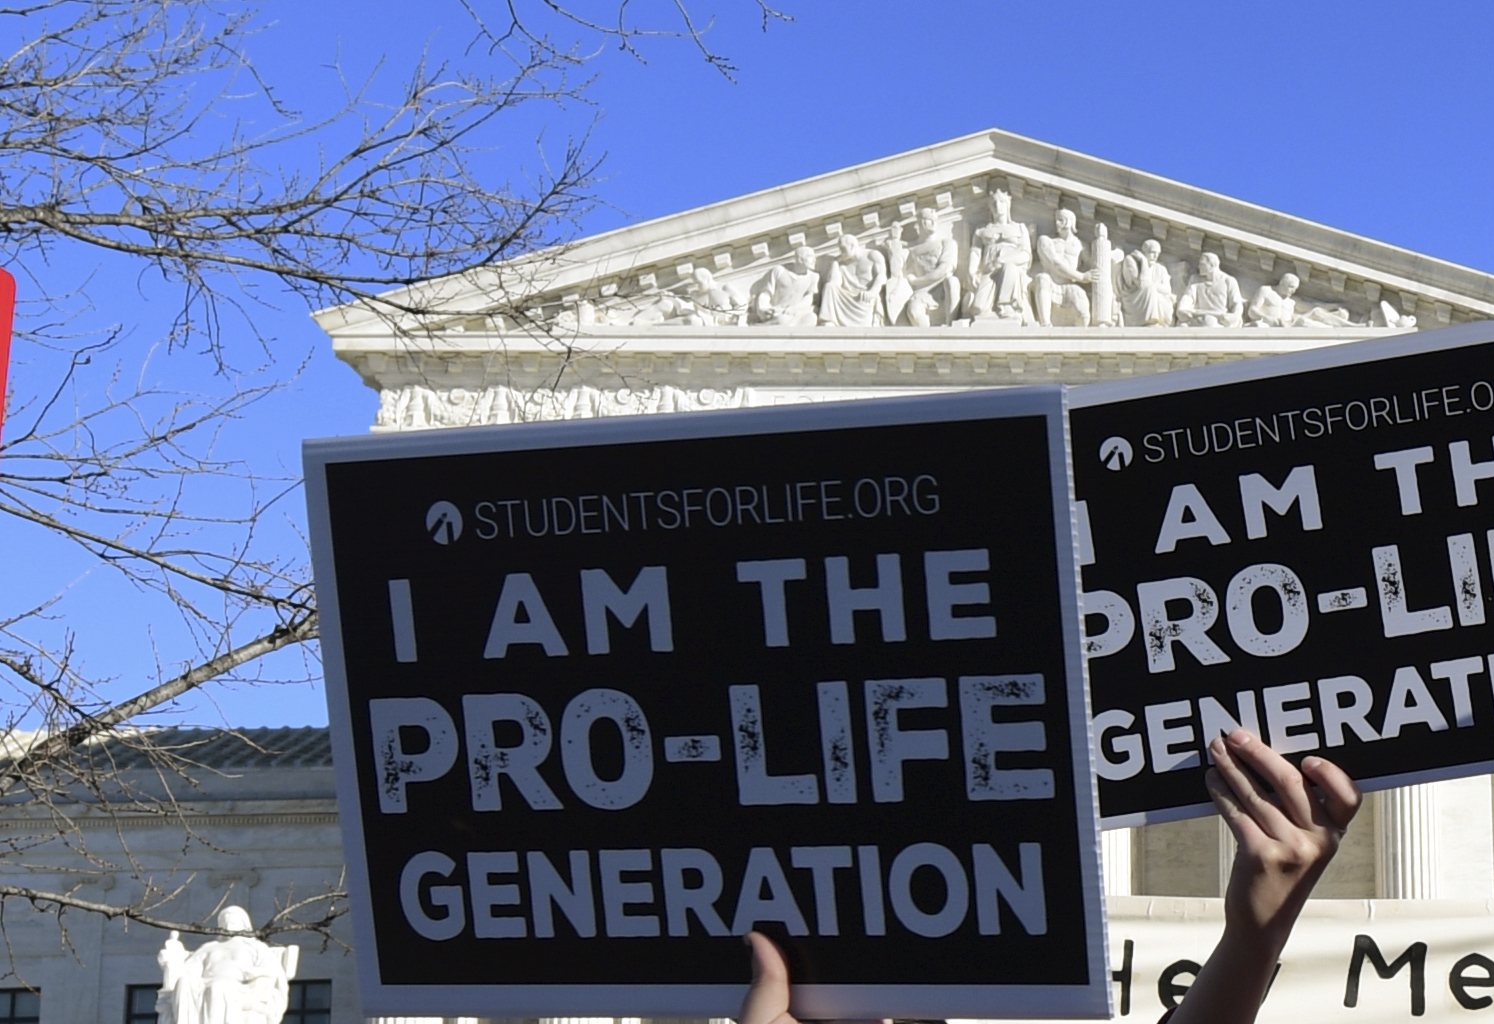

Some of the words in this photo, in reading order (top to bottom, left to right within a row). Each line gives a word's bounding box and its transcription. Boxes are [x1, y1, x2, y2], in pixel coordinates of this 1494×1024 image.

[475, 475, 940, 540] STUDENTSFORLIFE.ORG
[1155, 465, 1323, 555] AM
[388, 578, 418, 663] I
[483, 565, 674, 659] AM
[736, 548, 997, 648] THE
[368, 673, 1056, 814] PRO-LIFE
[399, 841, 1047, 942] GENERATION
